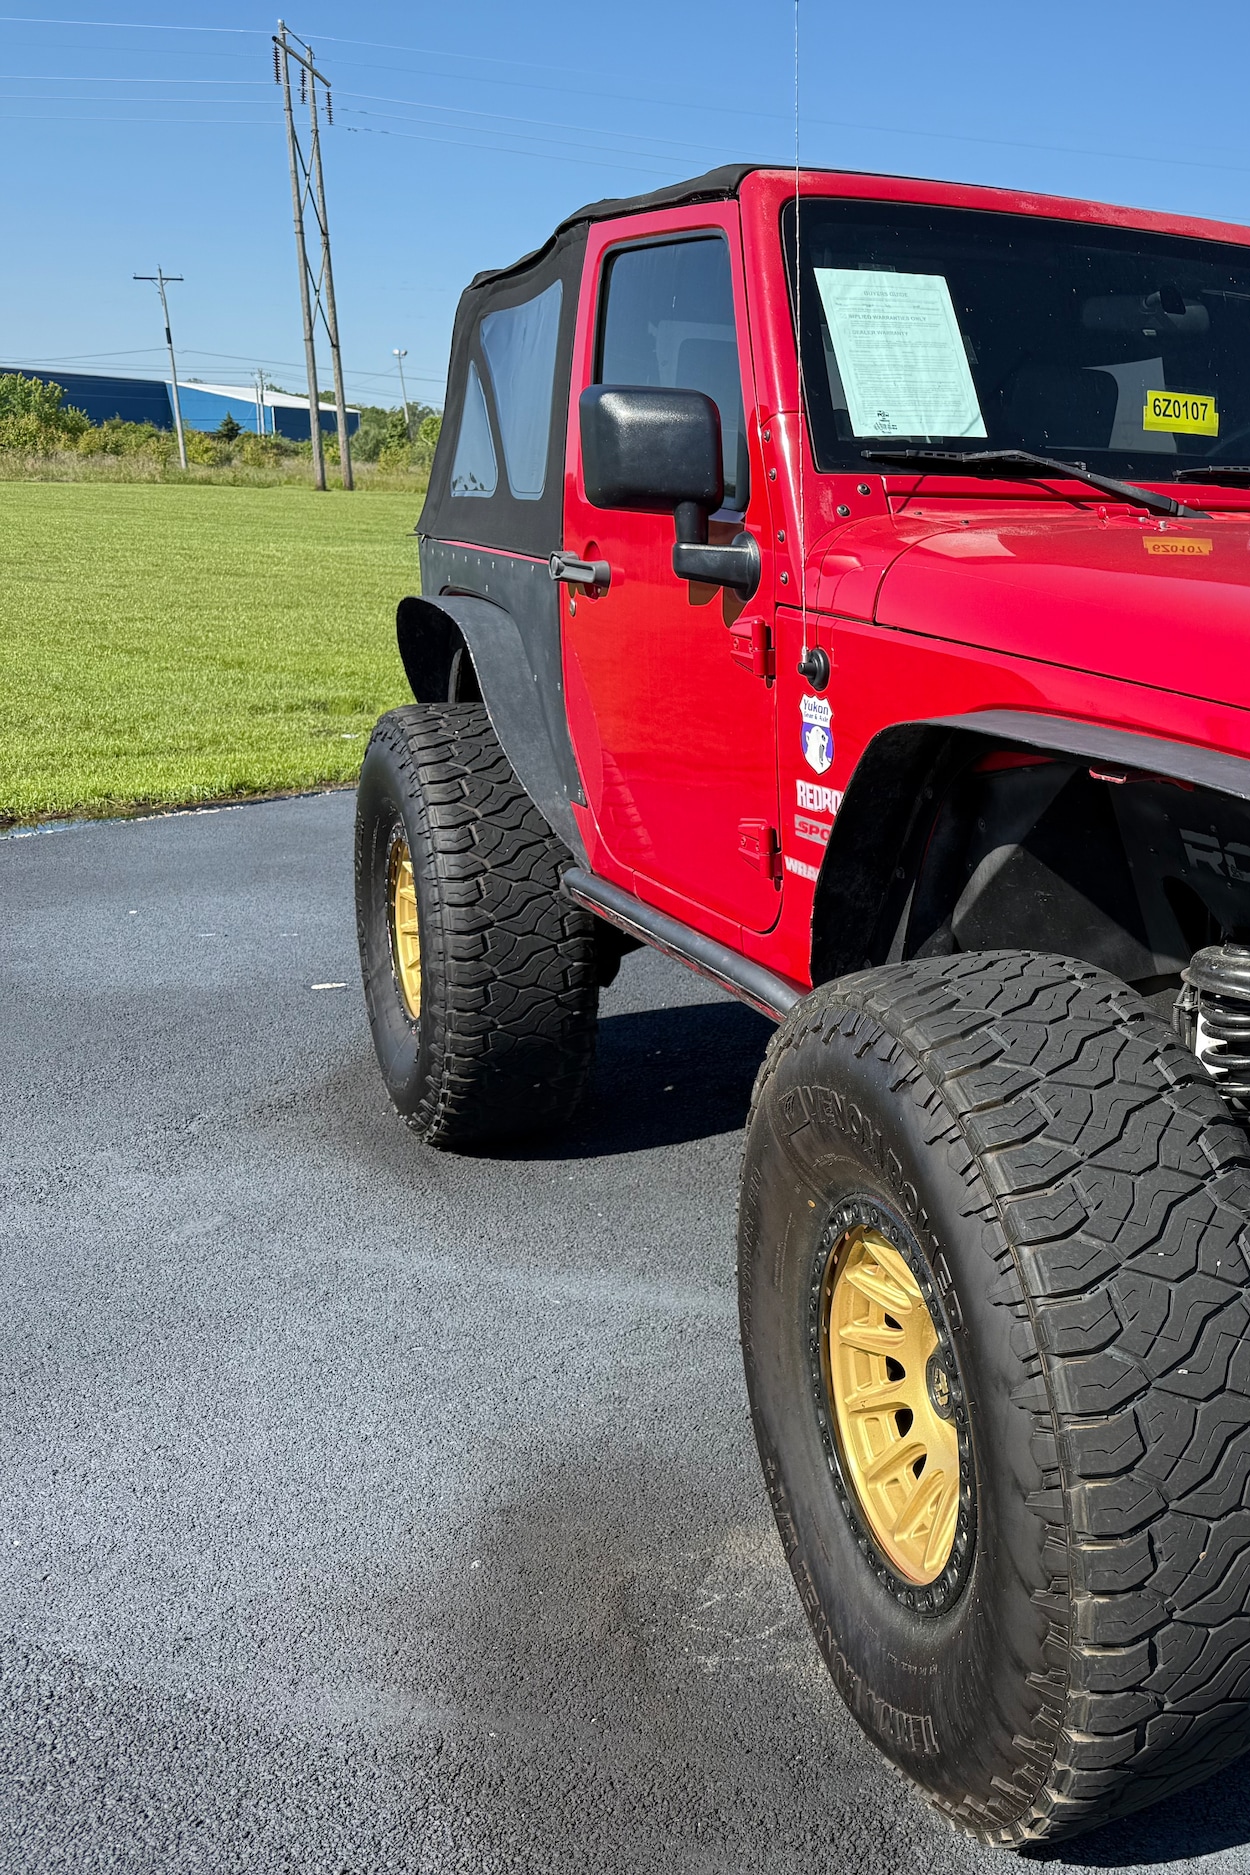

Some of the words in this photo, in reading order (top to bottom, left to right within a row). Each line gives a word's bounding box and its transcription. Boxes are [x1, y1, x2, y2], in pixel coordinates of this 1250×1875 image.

[1153, 398, 1208, 421] 6Z0107
[803, 699, 829, 715] Yukon
[796, 779, 844, 816] REDRO
